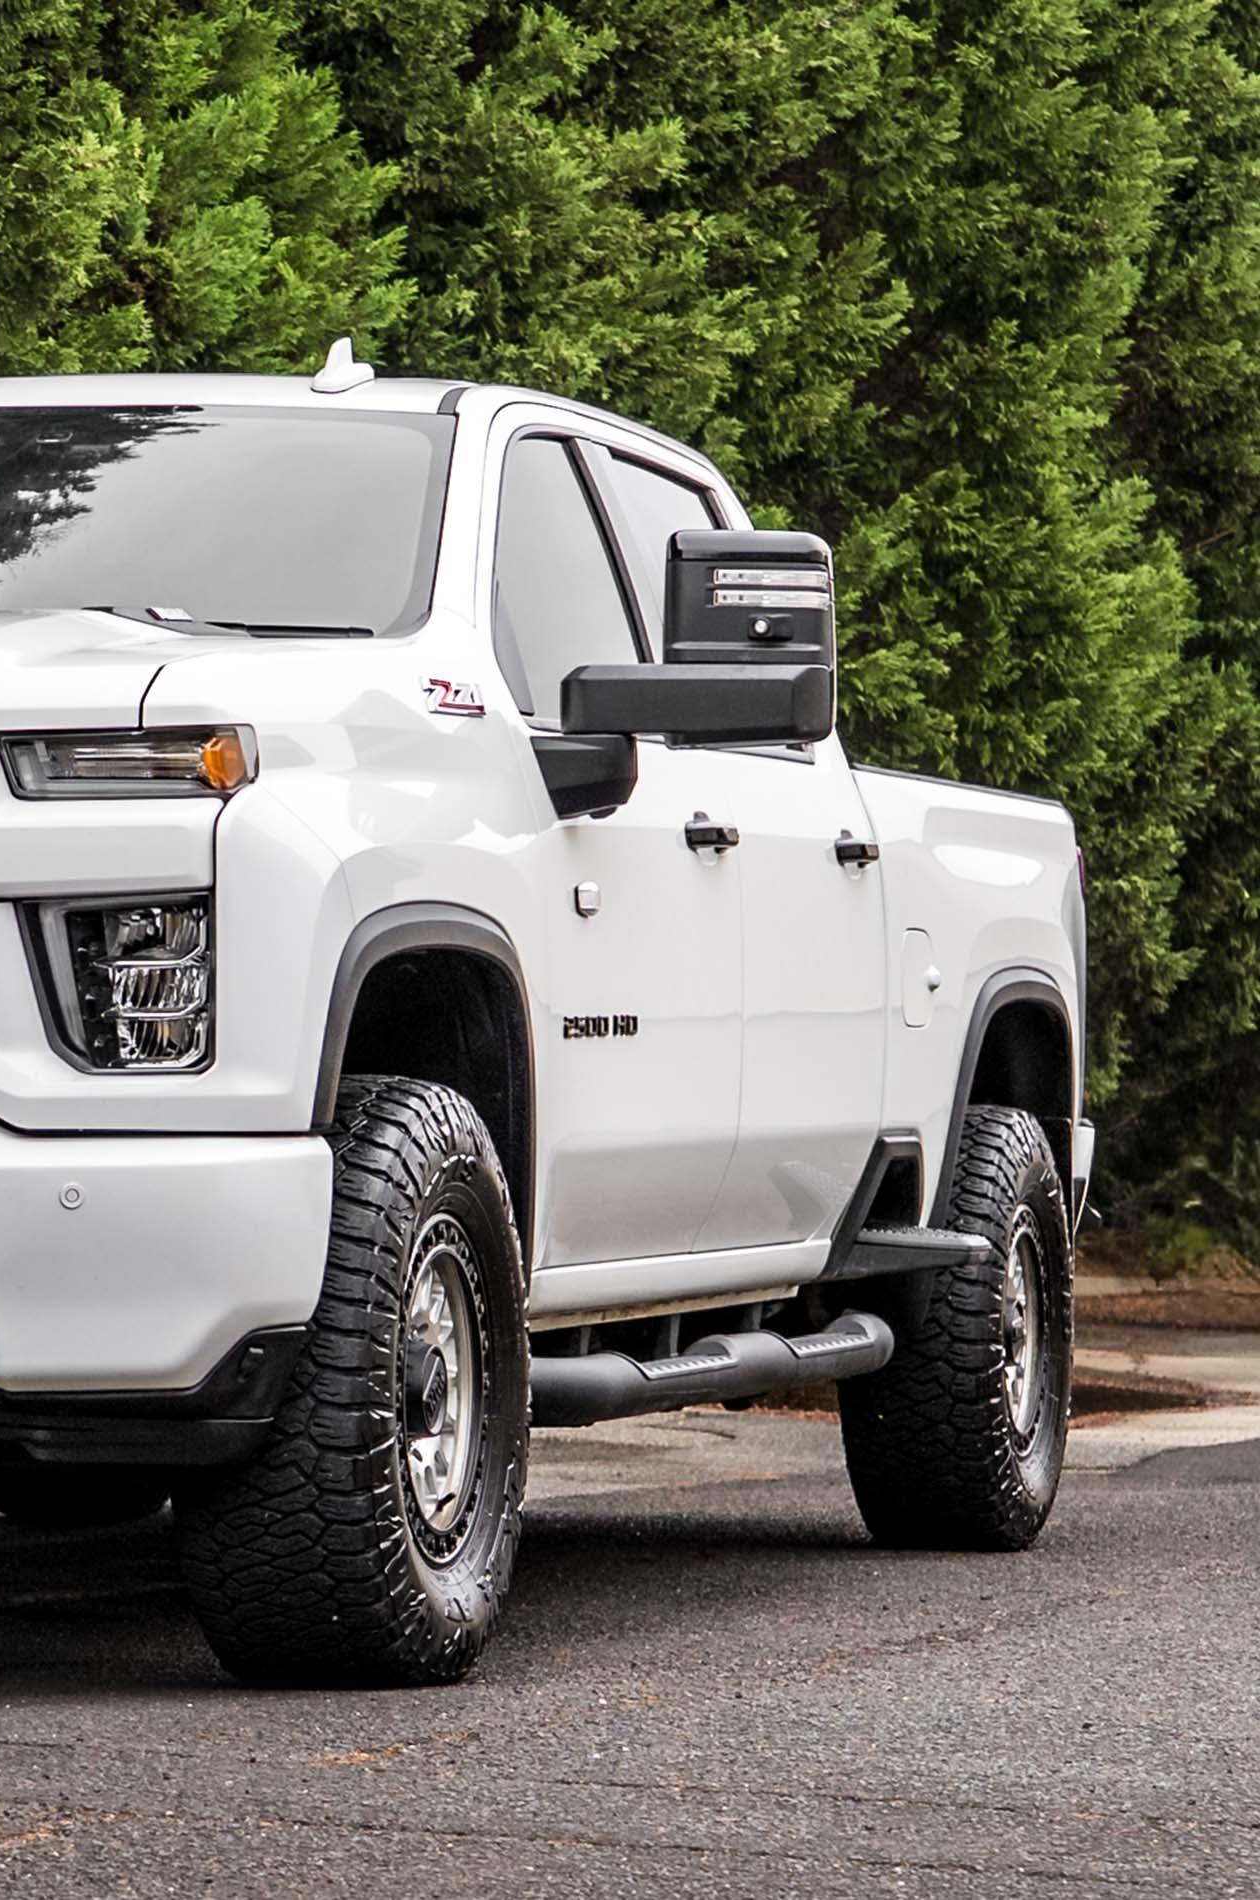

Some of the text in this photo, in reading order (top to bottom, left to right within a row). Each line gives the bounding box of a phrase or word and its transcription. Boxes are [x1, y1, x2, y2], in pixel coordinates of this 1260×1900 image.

[422, 678, 486, 718] Z71
[563, 1014, 638, 1039] 2500 HD
